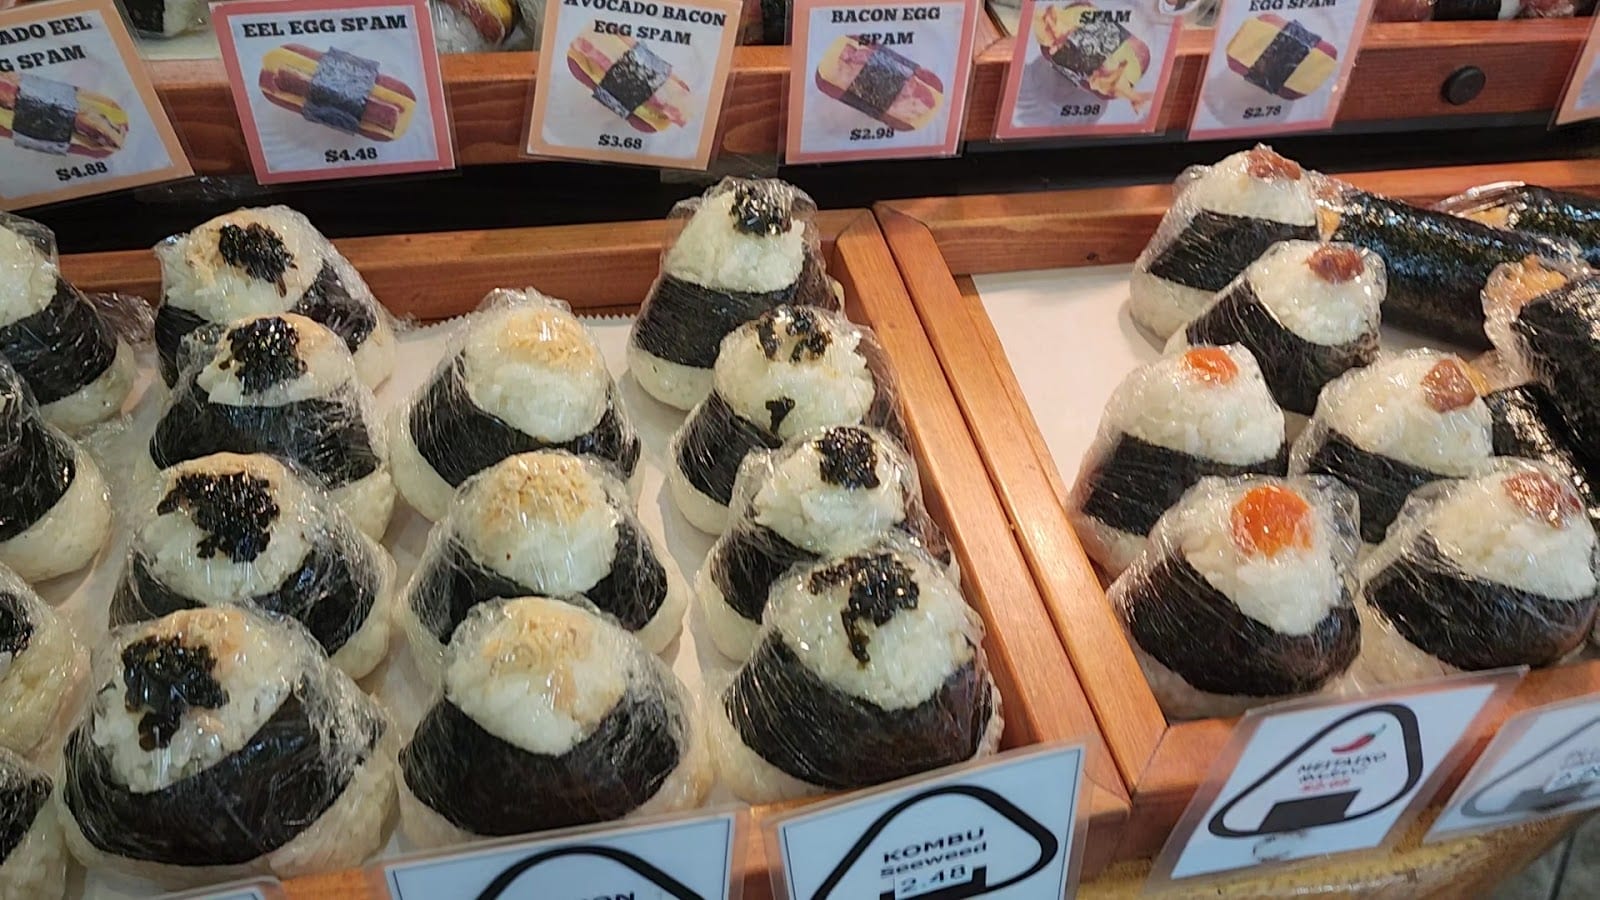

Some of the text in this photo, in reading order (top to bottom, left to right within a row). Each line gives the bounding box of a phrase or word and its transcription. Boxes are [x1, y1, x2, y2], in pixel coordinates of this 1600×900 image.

[831, 6, 941, 23] BACON EGG
[1248, 0, 1283, 12] EGG
[662, 6, 727, 27] BACON
[1079, 10, 1132, 24] SPAM
[47, 16, 93, 36] EEL
[242, 15, 407, 38] EEL EGG SPAM
[593, 19, 692, 46] EGG SPAM
[858, 32, 914, 46] SPAM
[17, 45, 86, 70] SPAM
[1060, 104, 1101, 117] $3.98
[1242, 106, 1282, 119] $2.78
[598, 134, 643, 150] $3.68
[849, 128, 895, 141] $2.98
[324, 147, 378, 163] $4.48
[56, 162, 108, 182] $4.88
[883, 827, 984, 864] KOMBU
[900, 864, 966, 894] 2.48
